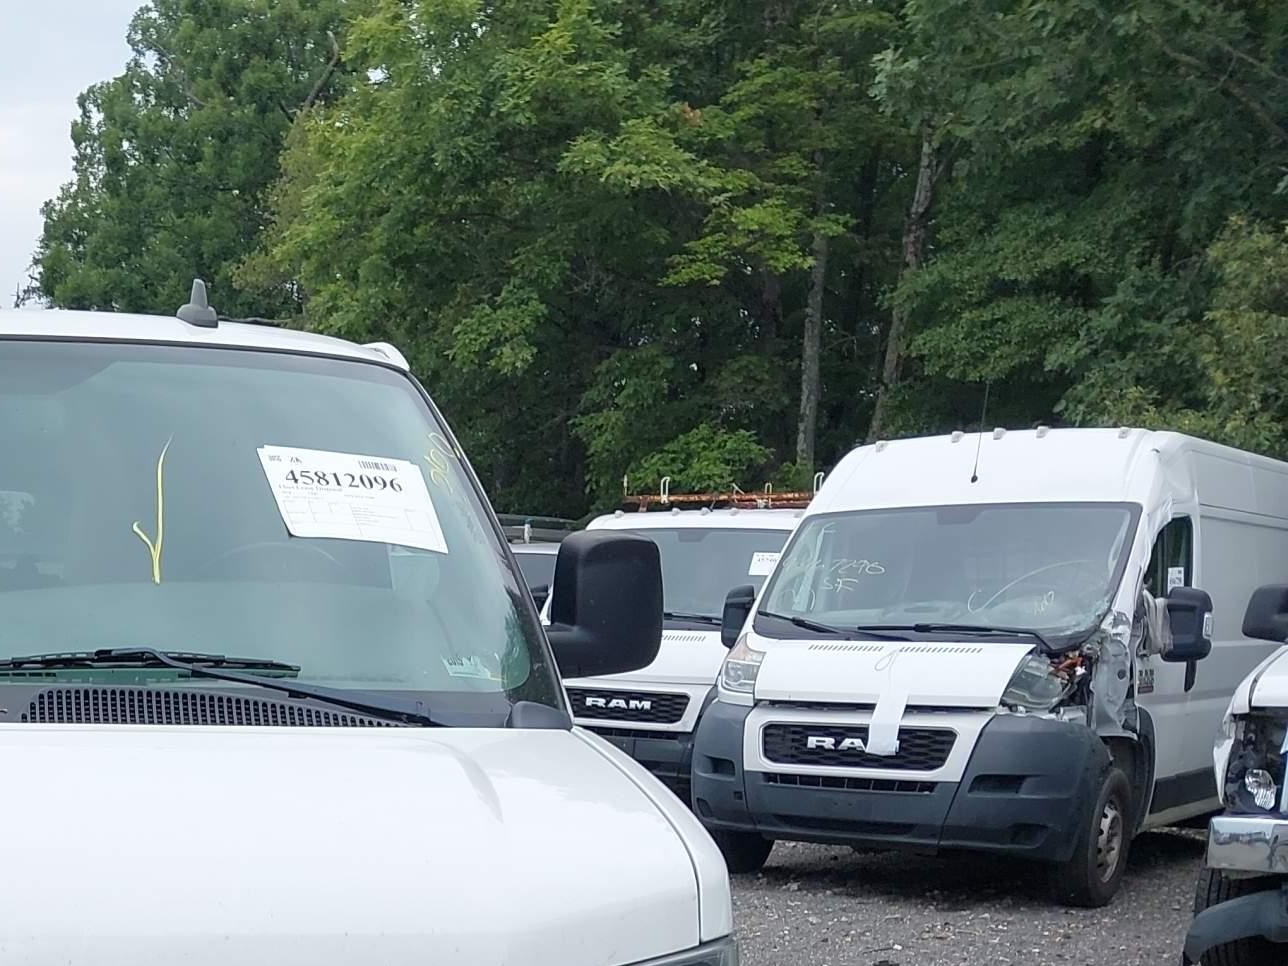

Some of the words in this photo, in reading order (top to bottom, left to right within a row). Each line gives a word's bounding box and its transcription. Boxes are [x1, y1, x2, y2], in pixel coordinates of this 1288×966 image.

[285, 468, 404, 493] 45812096
[585, 696, 652, 711] RAM
[806, 735, 900, 752] RA
